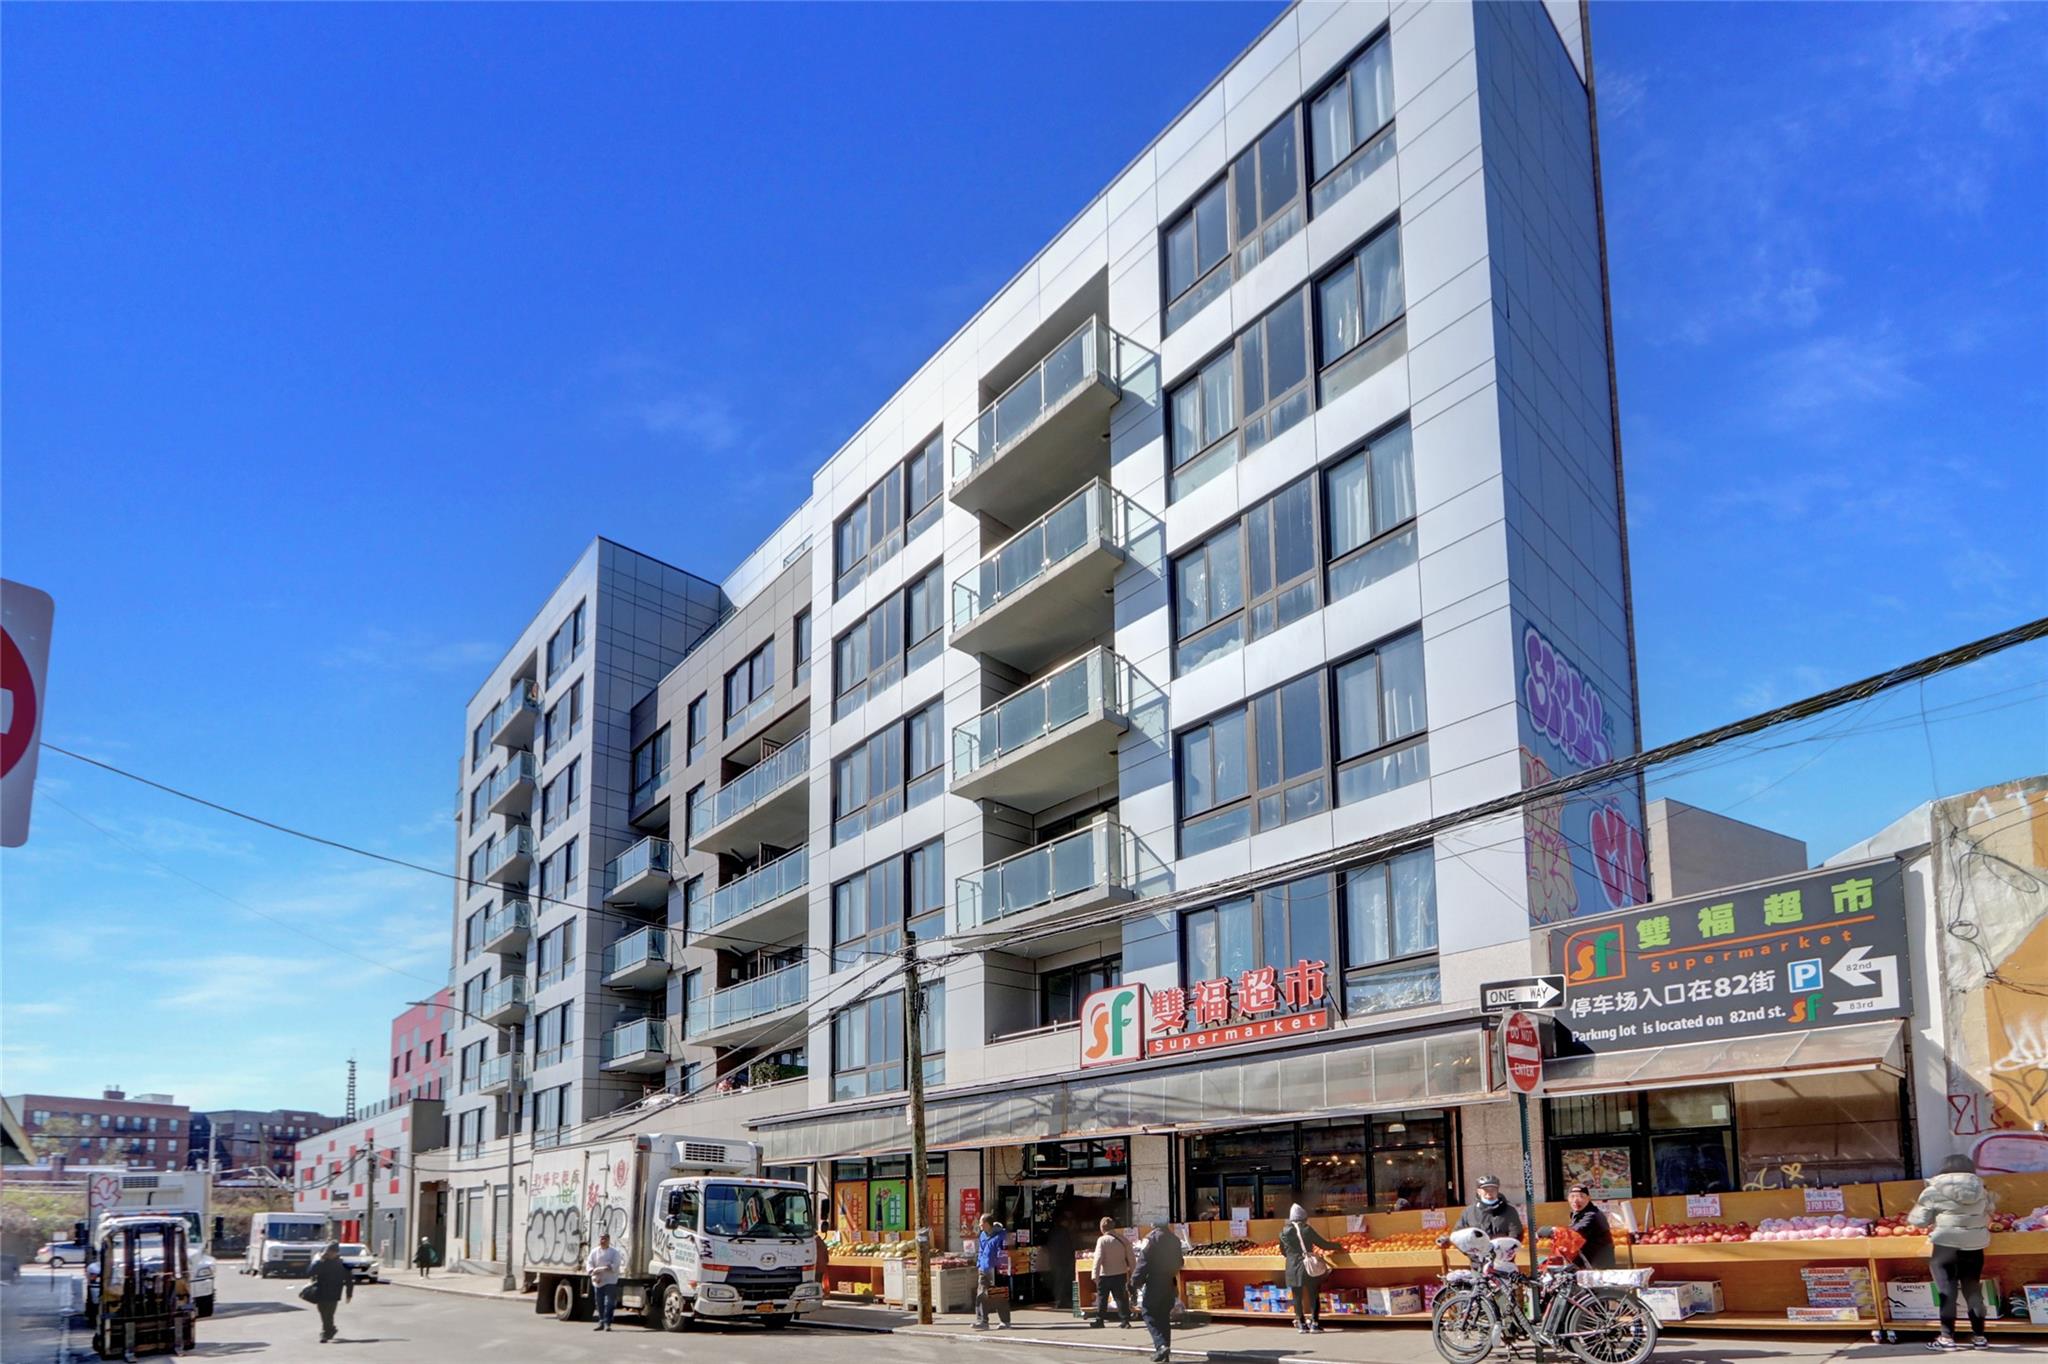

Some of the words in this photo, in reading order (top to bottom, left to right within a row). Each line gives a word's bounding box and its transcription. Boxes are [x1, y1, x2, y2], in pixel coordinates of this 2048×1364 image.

[1637, 878, 1873, 949] 雙福超市
[1651, 930, 1851, 973] Supermarket
[1846, 961, 1872, 971] 82nd
[1151, 960, 1326, 1033] 雙福超市
[1490, 989, 1516, 1003] ONE
[1530, 987, 1548, 999] WAY
[1570, 970, 1776, 1020] 停车场入口在82街
[1849, 1001, 1873, 1010] 83rd
[1155, 1014, 1317, 1052] Supermarket
[1510, 1026, 1519, 1039] DO
[1521, 1028, 1533, 1042] NOT
[1571, 1027, 1616, 1042] Parking
[1620, 1024, 1637, 1036] lot
[1643, 1022, 1653, 1034] is
[1655, 1015, 1704, 1033] located
[1706, 1014, 1723, 1026] on
[1729, 1005, 1765, 1023] 82nd
[1767, 1005, 1786, 1018] st.
[1514, 1063, 1535, 1077] ENTER
[1104, 1145, 1126, 1162] 45
